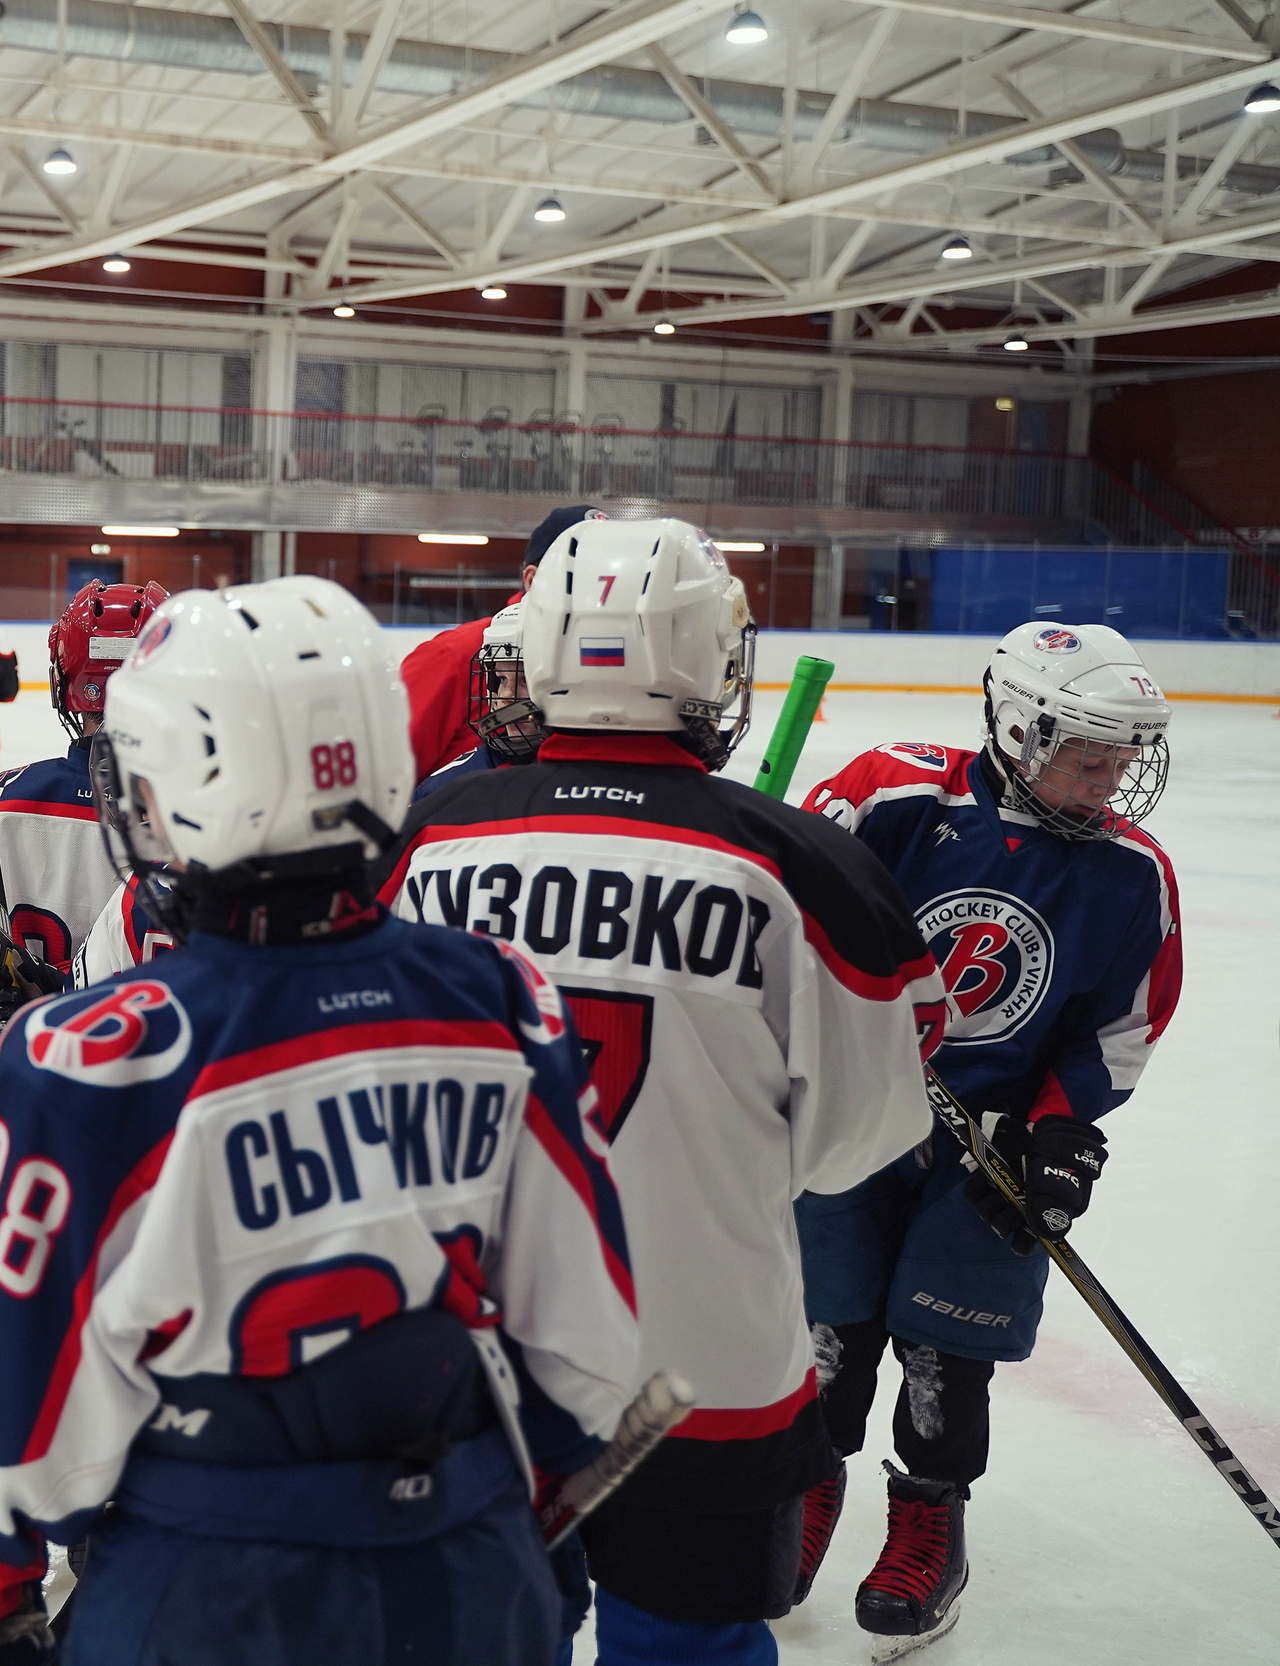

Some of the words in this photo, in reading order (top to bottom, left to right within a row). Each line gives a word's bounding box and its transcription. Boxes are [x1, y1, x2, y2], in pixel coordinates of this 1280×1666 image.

[598, 576, 616, 607] 7
[1002, 679, 1034, 700] BAUER
[1131, 721, 1168, 731] BAUER
[311, 741, 358, 790] 88
[554, 786, 645, 805] LUTCH
[925, 902, 1005, 931] HOCKEY
[1005, 915, 1041, 954] CLUB
[317, 989, 394, 1013] LUTCH
[1001, 967, 1042, 1019] VIKHR
[224, 1078, 506, 1232] СЫЧКОВ
[1074, 1152, 1100, 1168] LOCK
[991, 1158, 1020, 1193] SUPER
[911, 1291, 1012, 1328] BAUER
